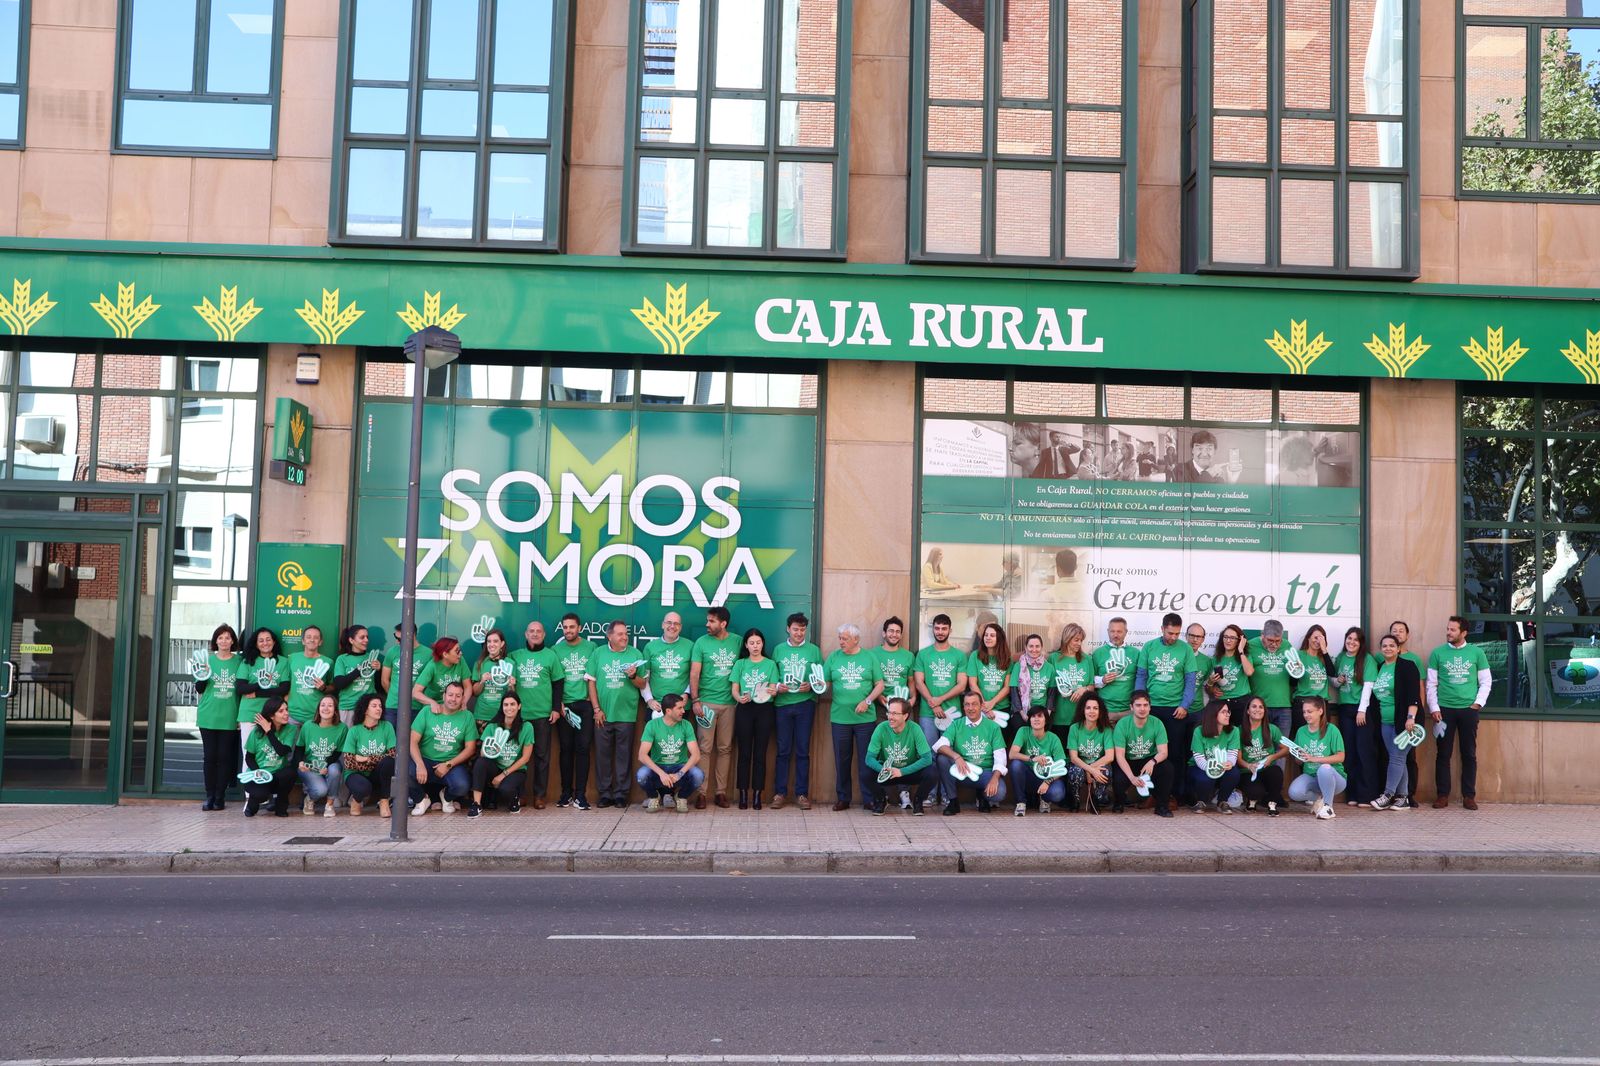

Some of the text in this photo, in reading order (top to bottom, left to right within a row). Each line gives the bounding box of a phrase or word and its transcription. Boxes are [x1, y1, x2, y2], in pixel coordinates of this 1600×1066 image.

[754, 298, 1104, 352] CAJA RURAL
[288, 465, 304, 484] 12 00
[1047, 485, 1067, 495] Caja
[1069, 486, 1093, 495] Rural,
[1111, 488, 1157, 496] CERRAMOS
[438, 468, 742, 540] SOMOS
[1036, 500, 1072, 509] obligaremos
[1008, 513, 1072, 523] COMUNICARÁS
[394, 538, 774, 610] ZAMORA
[1086, 564, 1158, 578] Porque somos
[1094, 565, 1342, 616] Gente como tú
[276, 594, 312, 608] 24 h.
[282, 628, 302, 636] AQUÍ
[633, 626, 647, 634] LA
